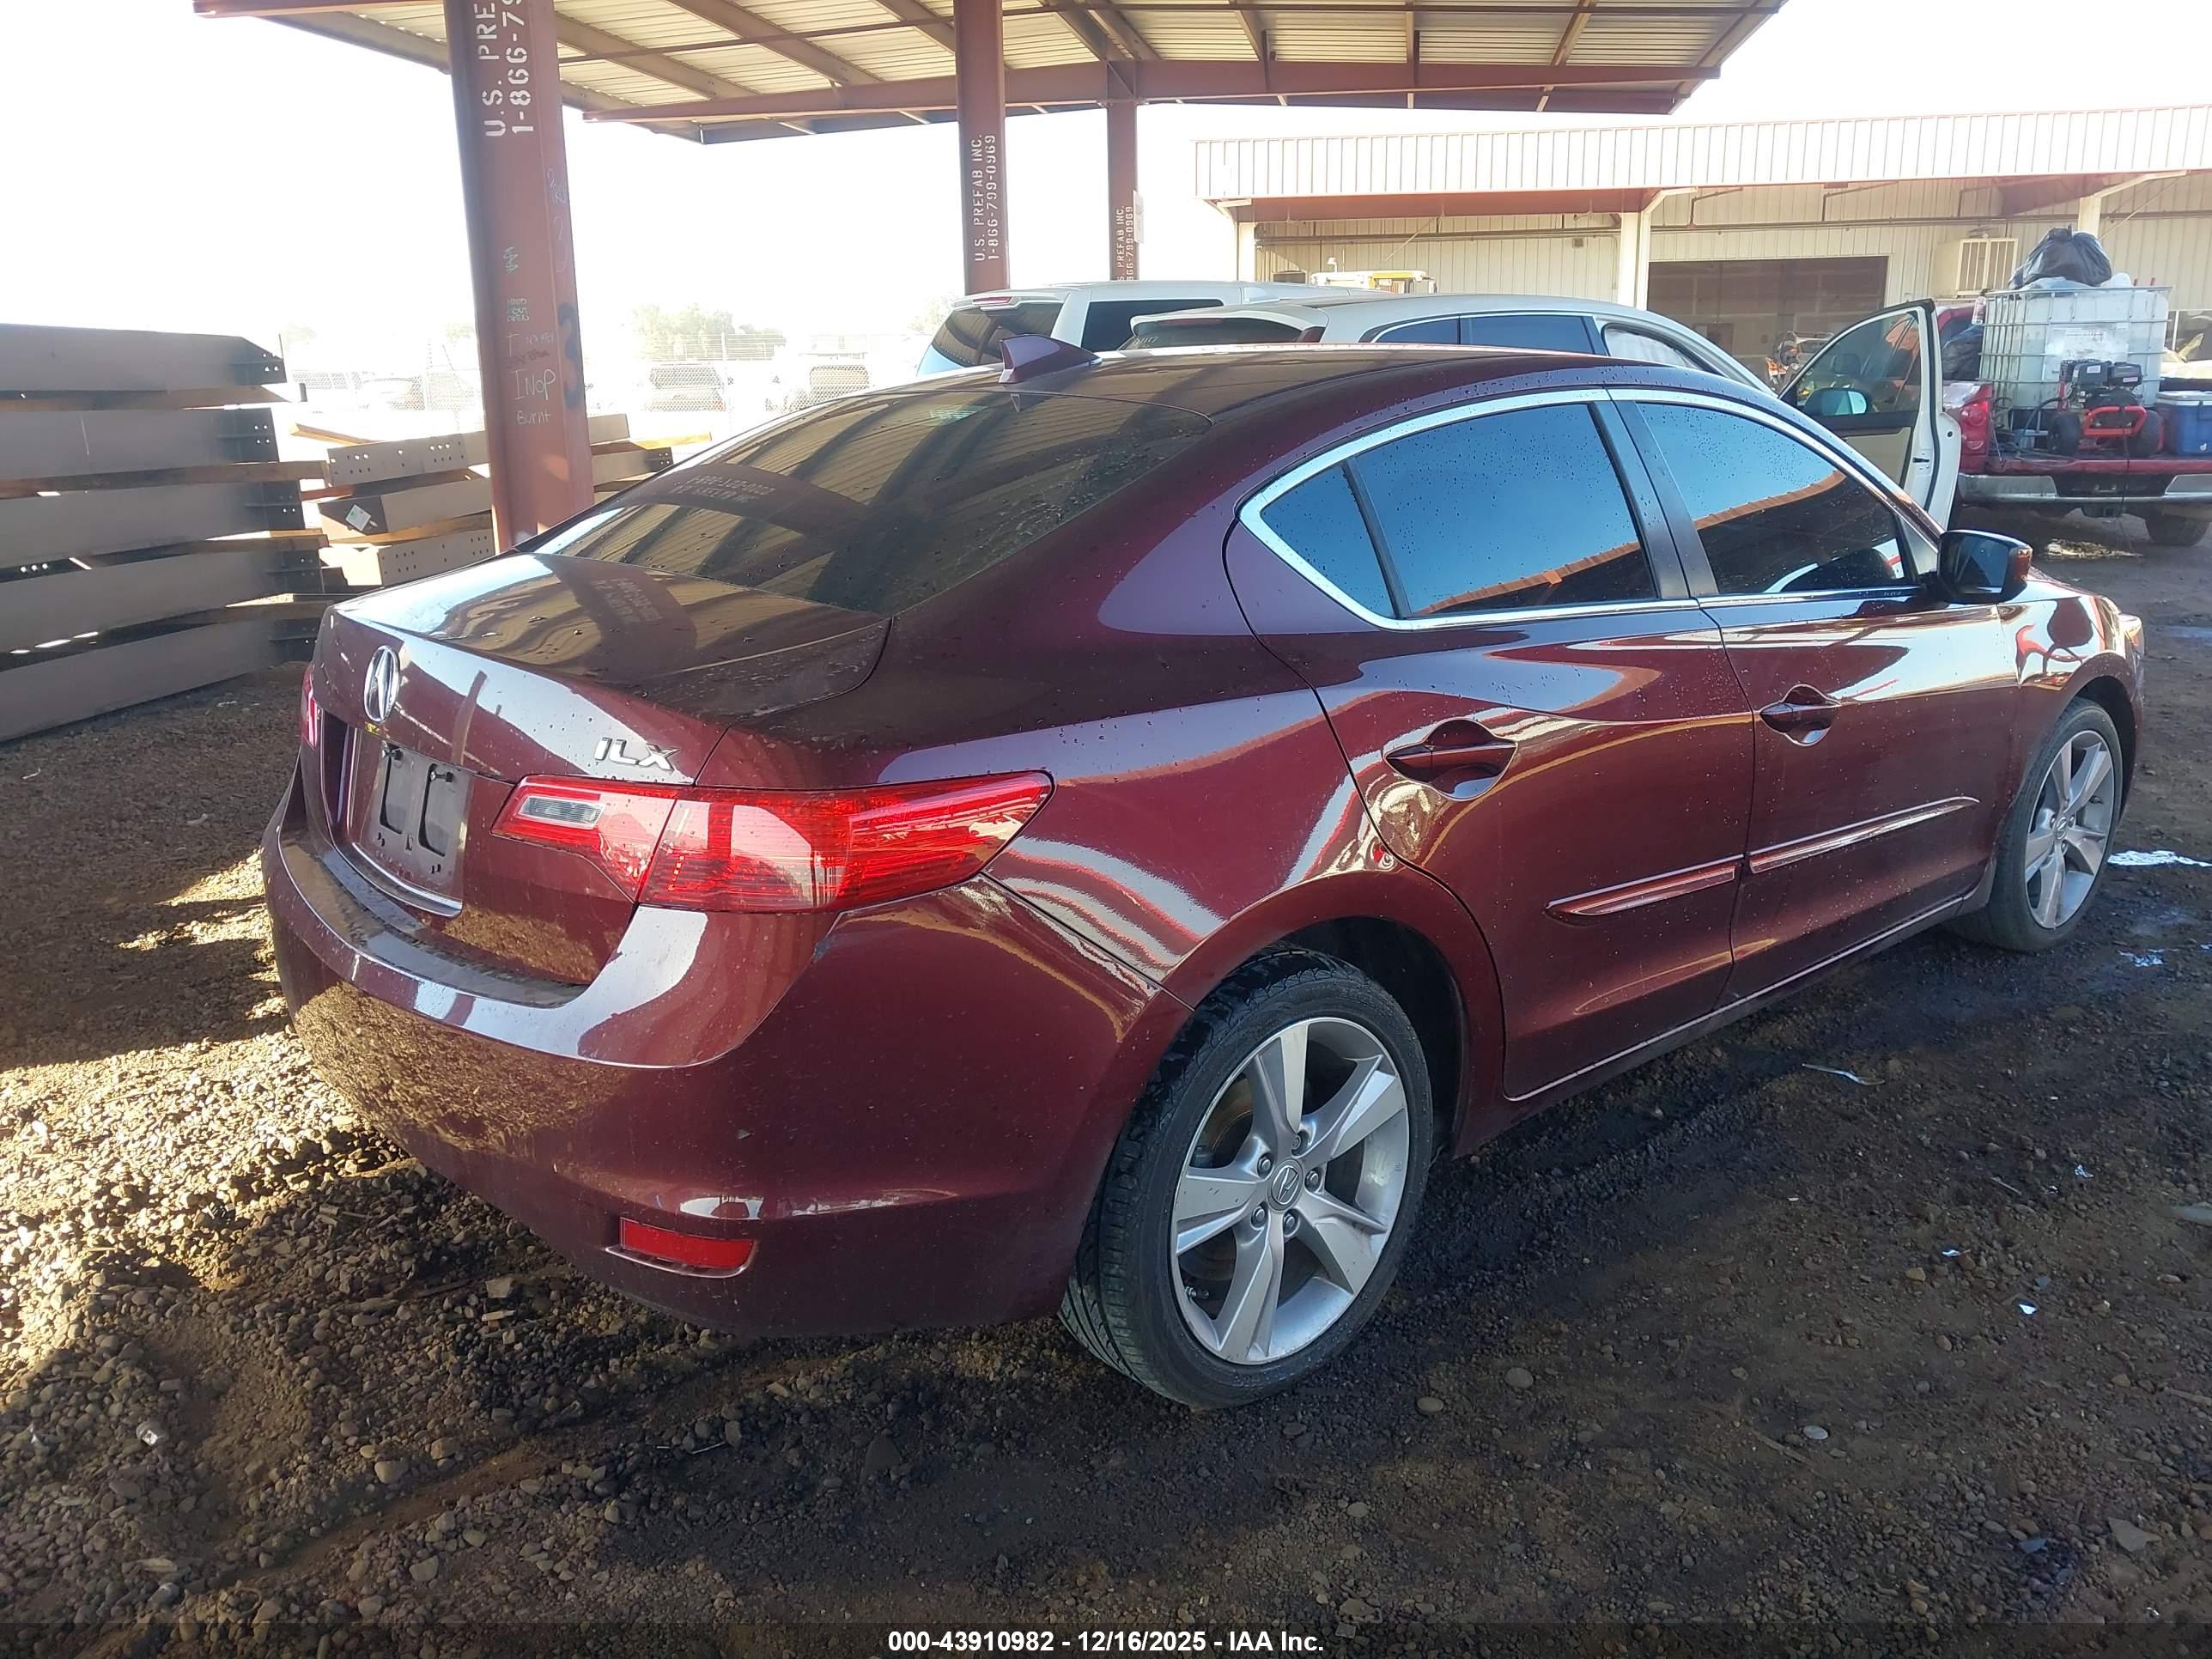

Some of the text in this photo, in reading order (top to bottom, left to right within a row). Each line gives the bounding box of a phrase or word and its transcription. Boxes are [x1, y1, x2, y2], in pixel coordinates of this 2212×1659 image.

[474, 3, 507, 137] U.S. PRE
[970, 134, 986, 261] U.S. PREFAB INC.
[1115, 205, 1125, 225] INC.
[1116, 229, 1125, 268] PREFAB
[594, 737, 681, 771] ILX
